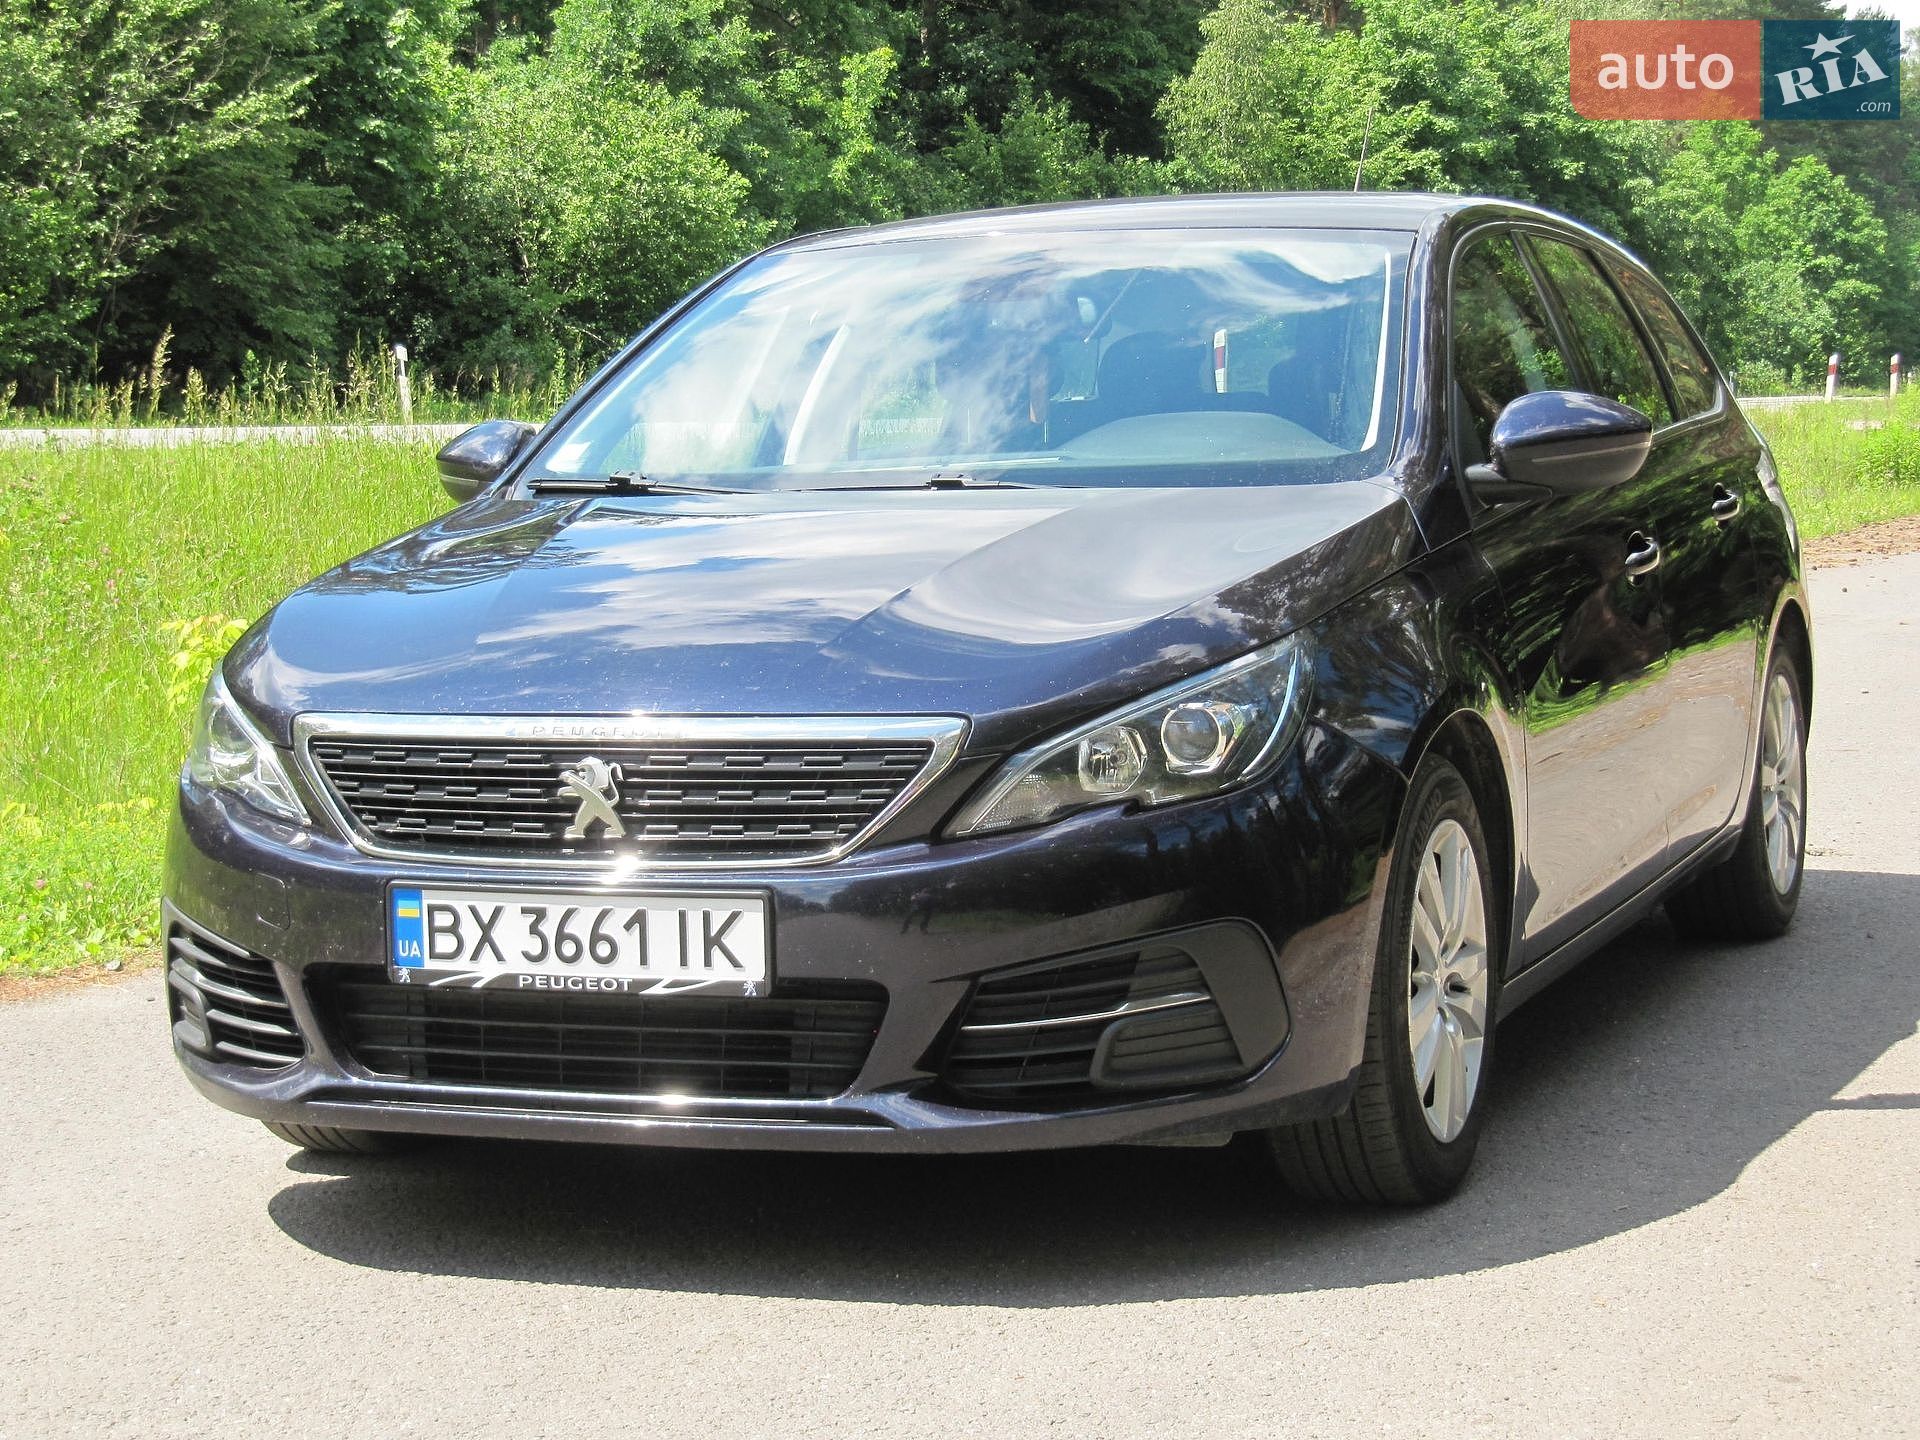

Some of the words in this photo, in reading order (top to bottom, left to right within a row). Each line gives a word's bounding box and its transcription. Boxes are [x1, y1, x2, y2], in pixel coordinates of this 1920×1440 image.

[427, 902, 507, 962] BX
[520, 905, 650, 968] 3661
[678, 908, 745, 969] IK
[398, 939, 422, 959] UA
[518, 974, 633, 992] PEUGEOT
